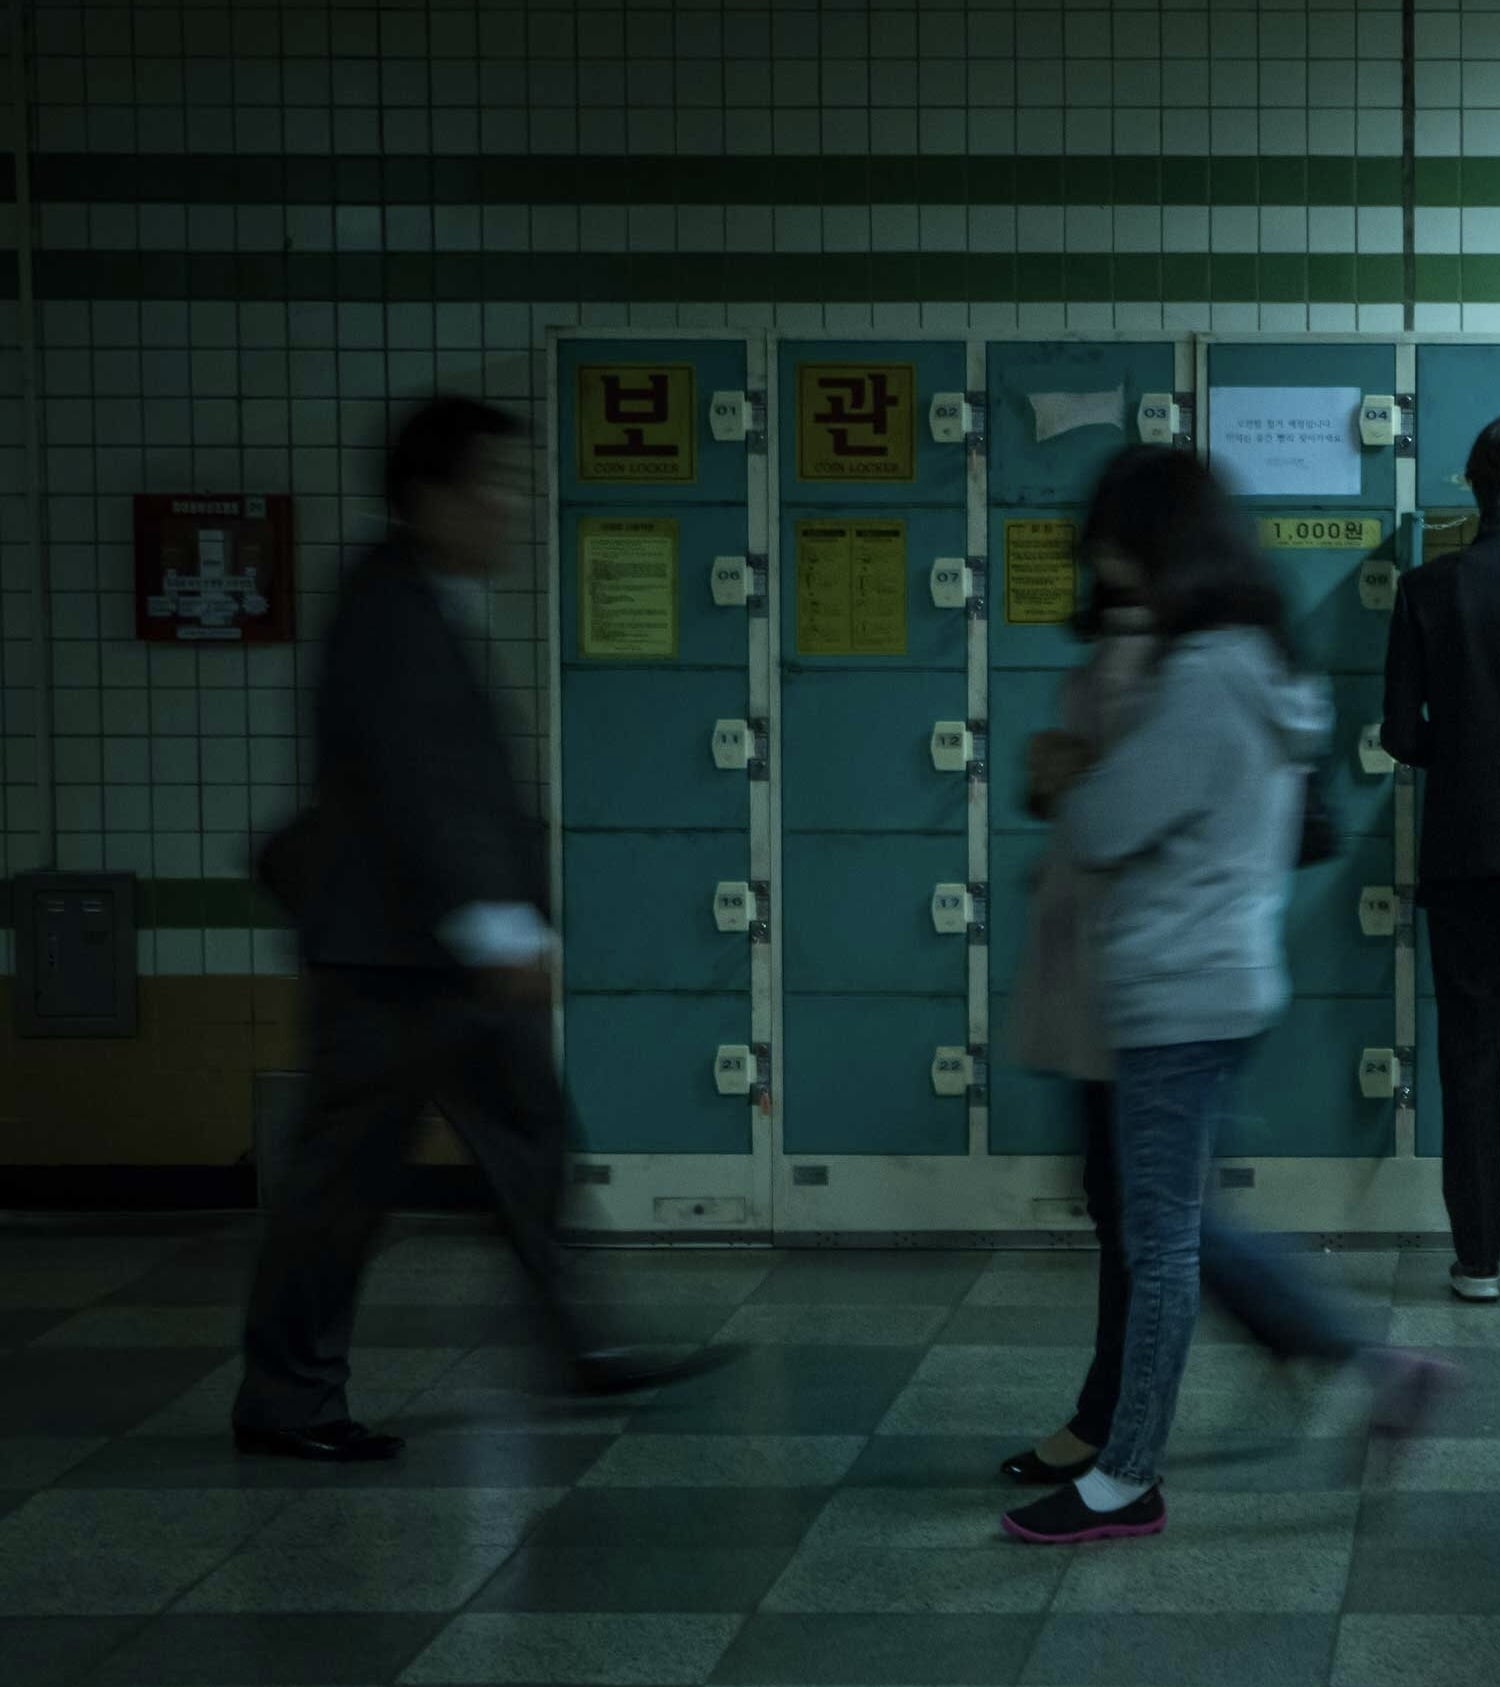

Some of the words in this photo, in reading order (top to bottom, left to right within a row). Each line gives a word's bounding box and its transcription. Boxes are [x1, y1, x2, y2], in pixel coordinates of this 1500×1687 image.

[593, 375, 678, 456] 보
[715, 405, 736, 416] 01
[814, 374, 899, 456] 관
[935, 407, 957, 418] 02
[1143, 408, 1167, 418] 03
[1365, 410, 1388, 421] 04
[594, 462, 625, 474] COIN
[630, 462, 679, 474] LOCKER
[814, 461, 845, 473] COIN
[849, 461, 899, 473] LOCKER
[1273, 521, 1363, 541] 1,000원
[718, 570, 740, 581] 06
[937, 572, 959, 582] 07
[721, 734, 738, 744] 11
[941, 735, 960, 746] 12
[941, 898, 960, 908] 17
[722, 1060, 741, 1070] 21
[940, 1060, 961, 1071] 22
[1366, 1063, 1387, 1073] 24
